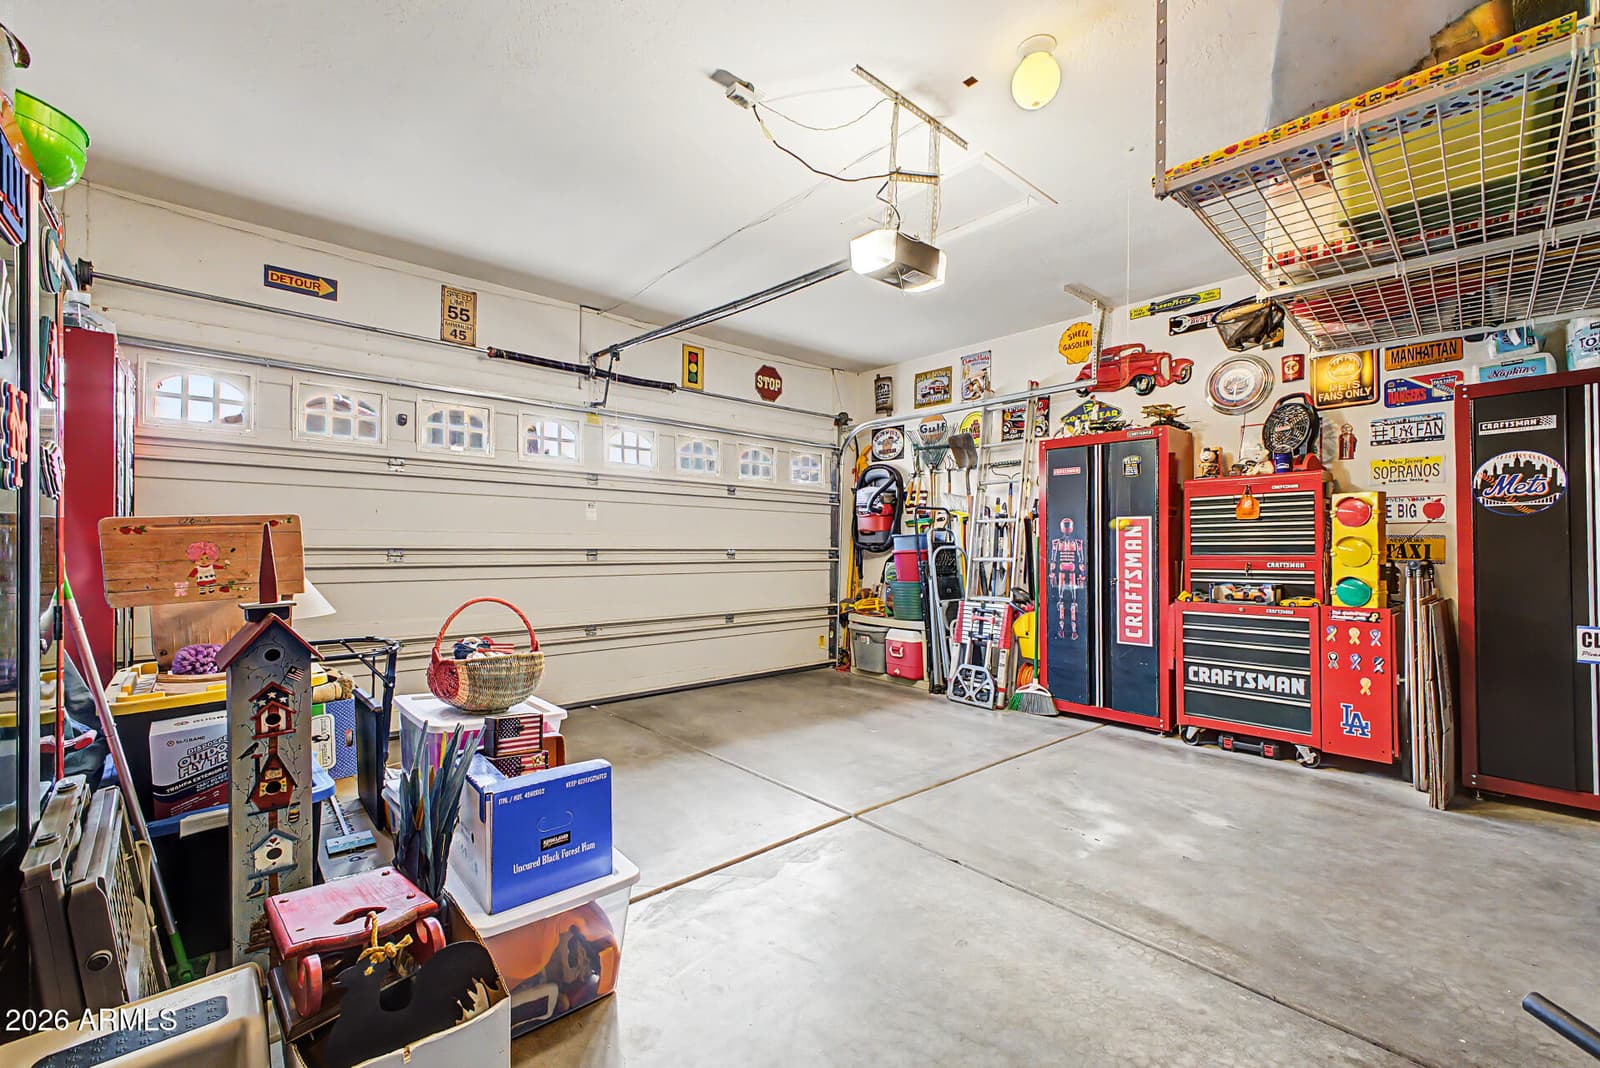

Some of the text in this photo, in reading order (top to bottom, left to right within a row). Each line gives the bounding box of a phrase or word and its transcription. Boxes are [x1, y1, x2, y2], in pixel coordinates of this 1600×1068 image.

[270, 272, 321, 291] DETOUR
[446, 290, 473, 302] SPEED
[450, 299, 470, 307] LIMIT
[447, 305, 470, 323] 55
[450, 328, 467, 341] 45
[1067, 330, 1089, 342] SHELL
[1579, 337, 1600, 348] TO
[1062, 338, 1093, 352] GASOLIN
[1391, 340, 1457, 364] MANHATTAN
[1490, 365, 1537, 379] Napkins
[756, 374, 781, 392] STOP
[1329, 380, 1361, 392] METS
[1318, 386, 1372, 403] FANS ONLY
[919, 421, 946, 434] Gulf
[1416, 419, 1443, 437] FAN
[1481, 417, 1539, 431] CRAFTSMAN
[1373, 462, 1441, 480] SOPRANOS
[1482, 472, 1549, 498] Mets
[1397, 503, 1418, 518] BIG
[1386, 543, 1431, 559] TAXI
[1266, 561, 1305, 569] CRAFTSMAN
[1124, 524, 1144, 639] CRAFTSMAN
[1581, 631, 1600, 649] CL
[1188, 665, 1306, 696] CRAFTSMAN
[1341, 704, 1370, 738] LA
[178, 742, 228, 768] OUTDO
[178, 751, 229, 780] FLY TR
[565, 781, 577, 789] KEEP
[513, 841, 596, 874] Uncured Black Forest Ham
